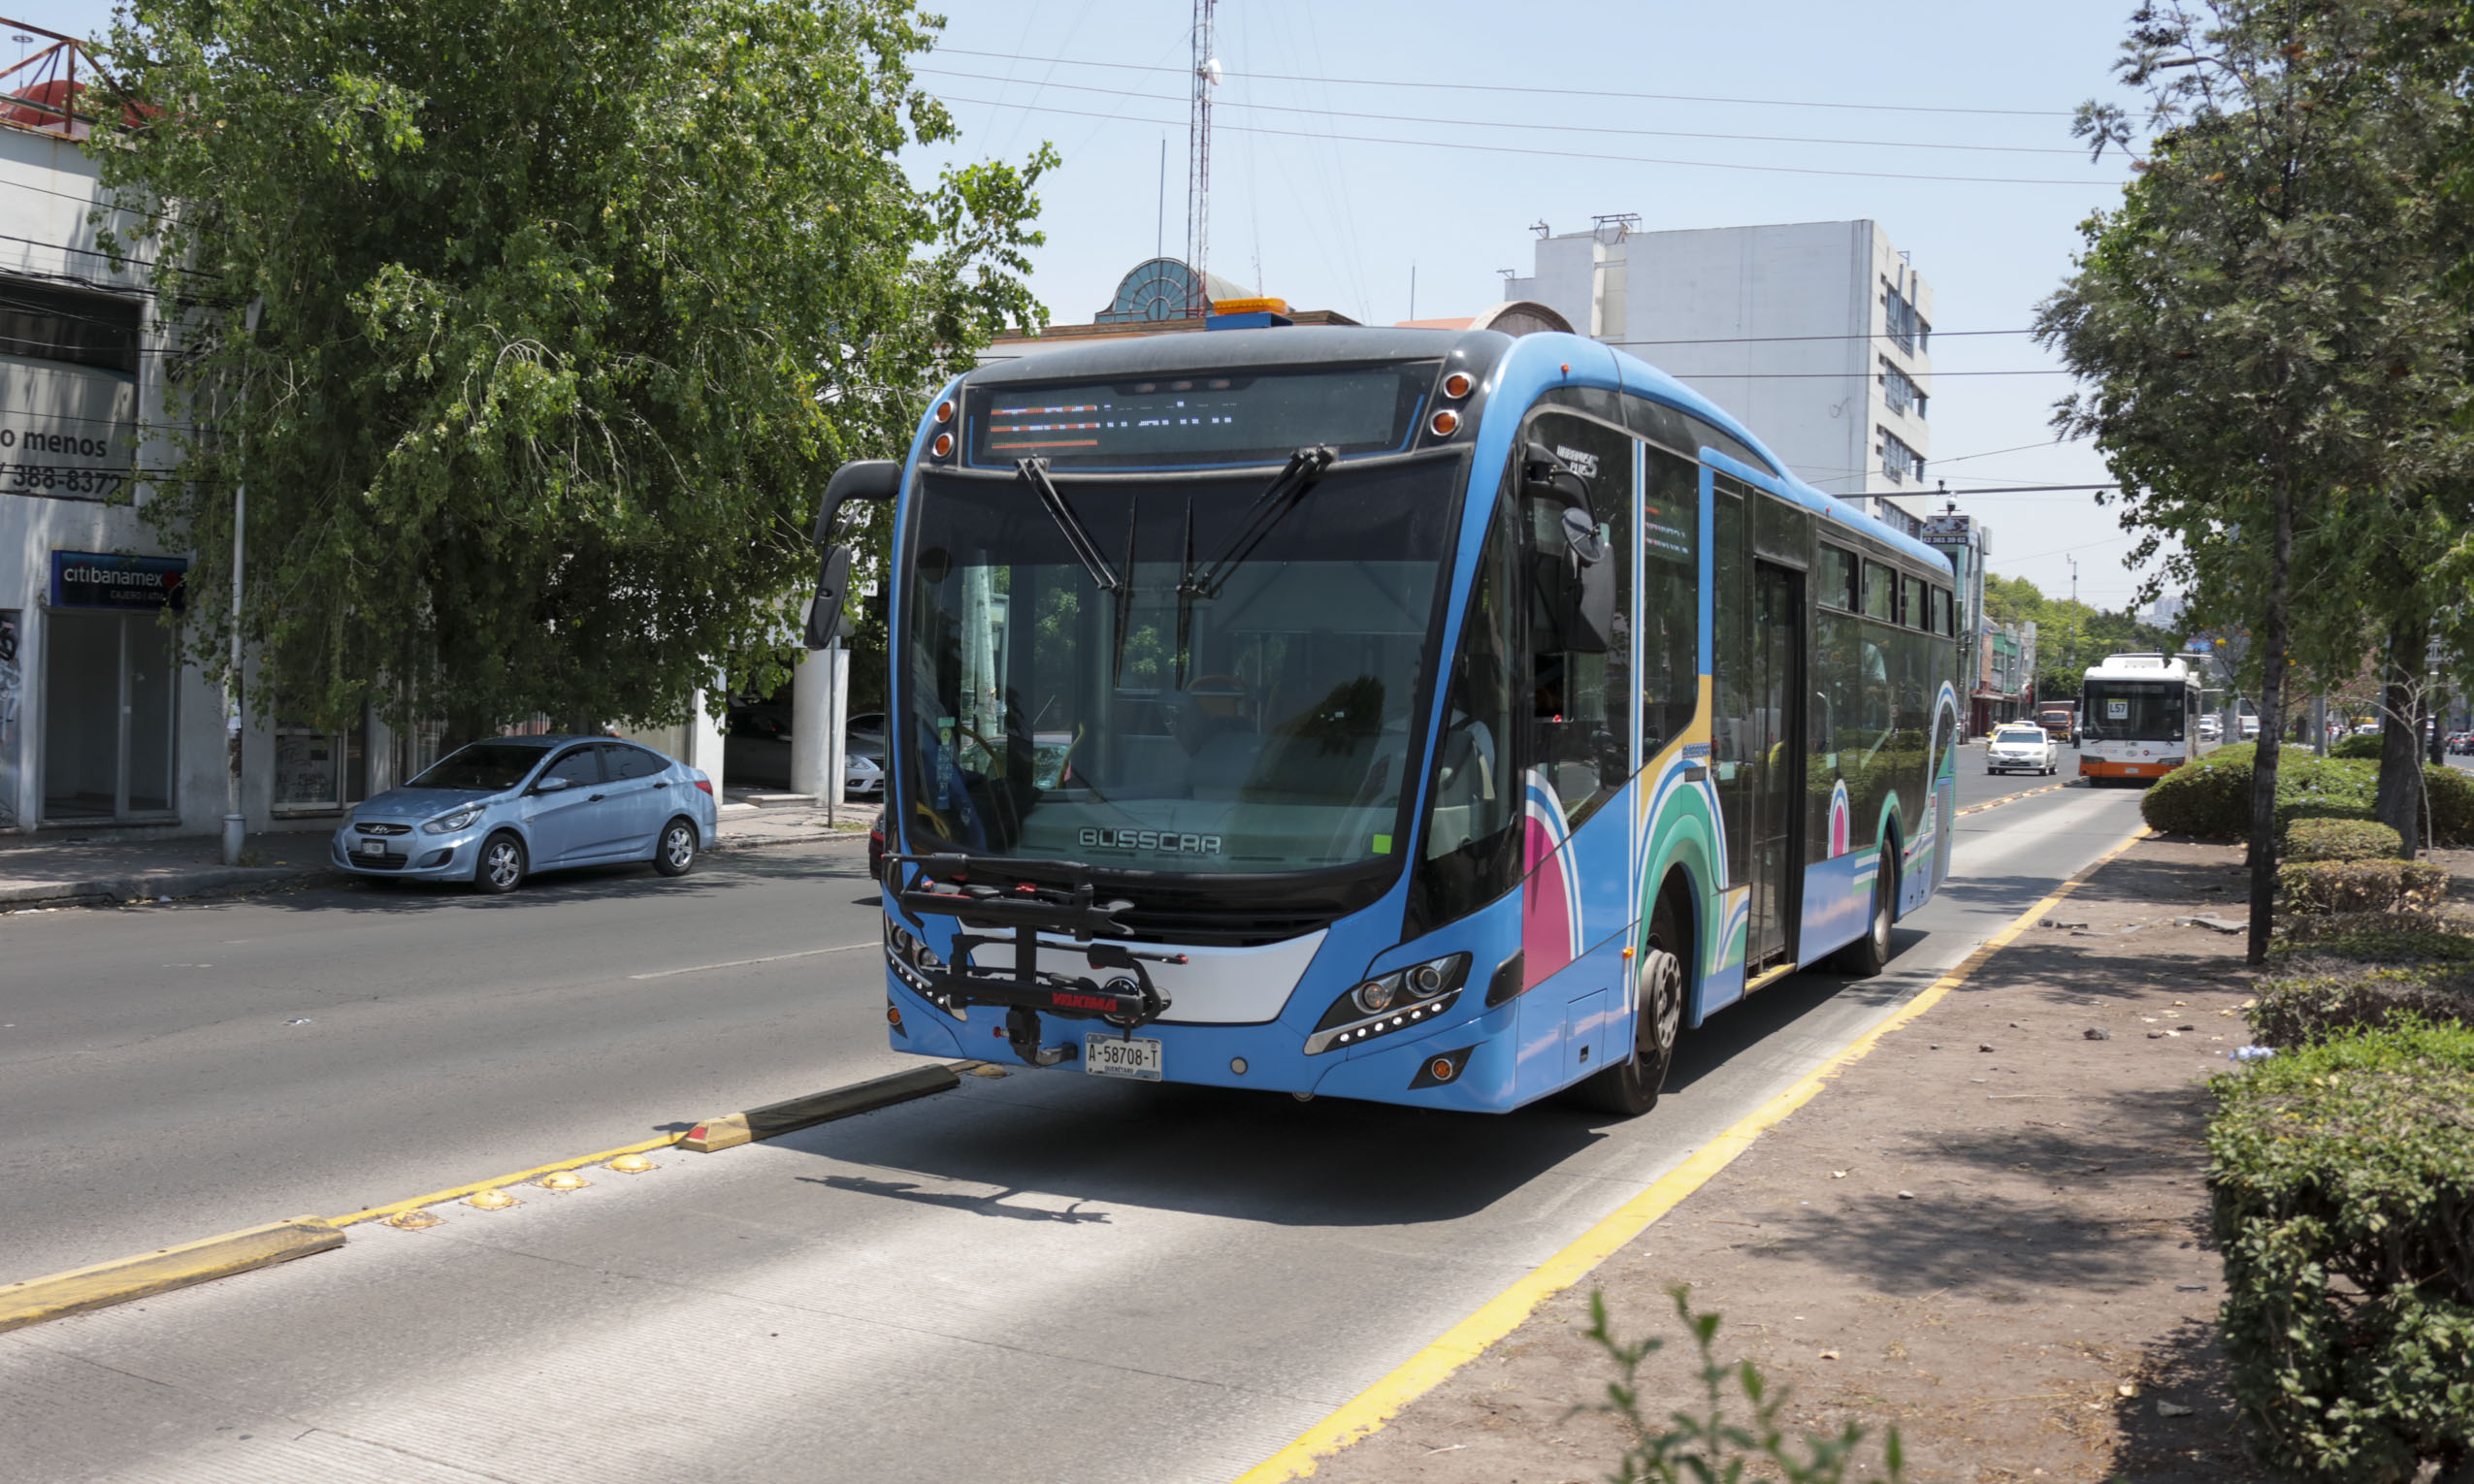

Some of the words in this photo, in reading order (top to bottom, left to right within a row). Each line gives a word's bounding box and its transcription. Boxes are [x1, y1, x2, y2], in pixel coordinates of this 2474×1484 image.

[23, 431, 107, 457] menos
[13, 464, 122, 495] 388-8372
[63, 565, 164, 587] citibanamex
[2109, 703, 2126, 713] L57
[1078, 827, 1222, 855] BUSSCAR
[1052, 992, 1117, 1012] YAKIMA
[1088, 1044, 1157, 1068] A-58708-T
